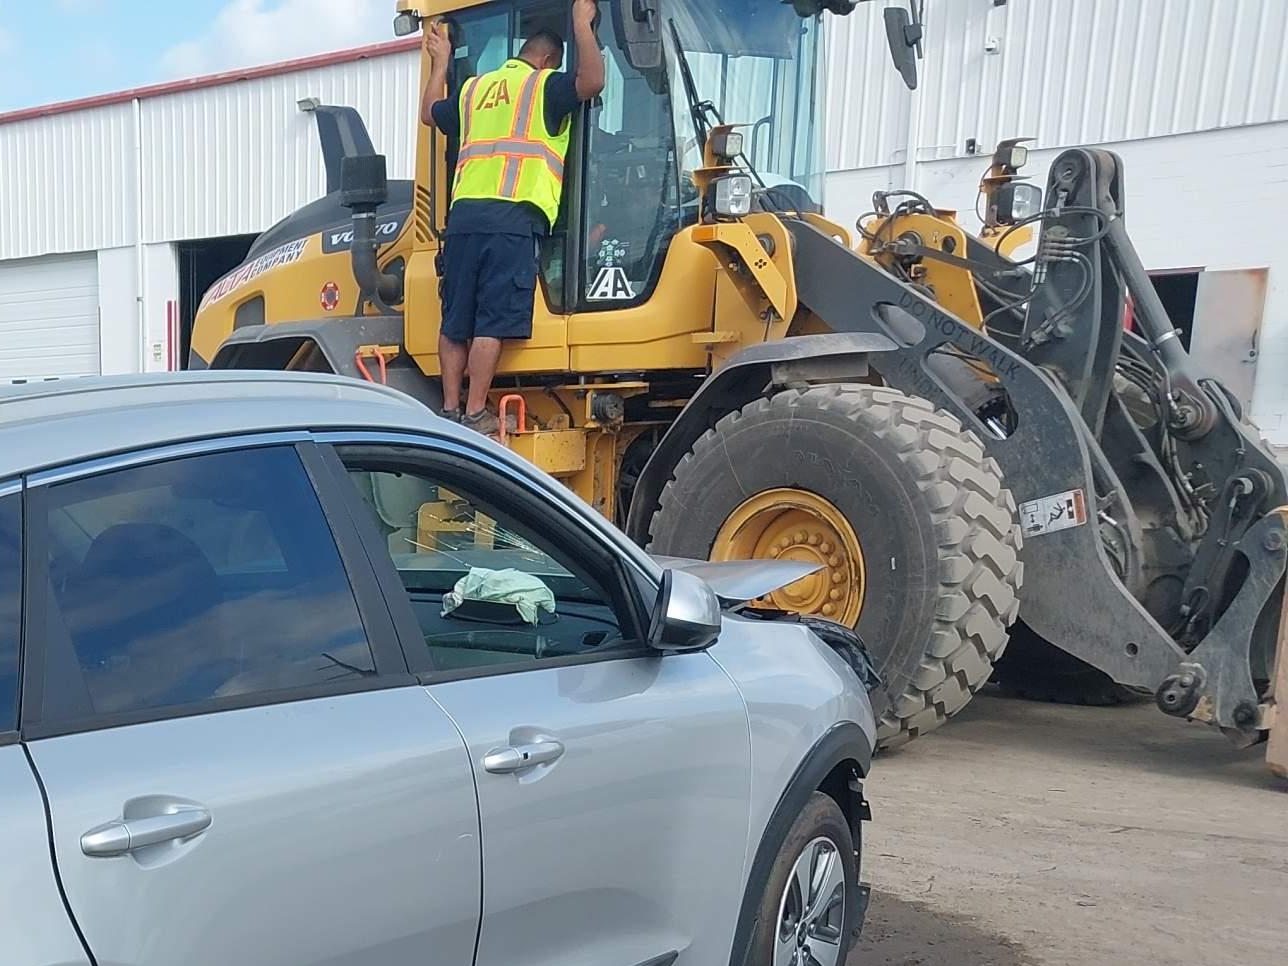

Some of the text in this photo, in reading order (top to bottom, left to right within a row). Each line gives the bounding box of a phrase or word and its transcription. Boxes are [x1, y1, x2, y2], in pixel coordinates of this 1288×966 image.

[250, 250, 304, 279] COMPANY
[898, 292, 1021, 381] DO NOT WALK
